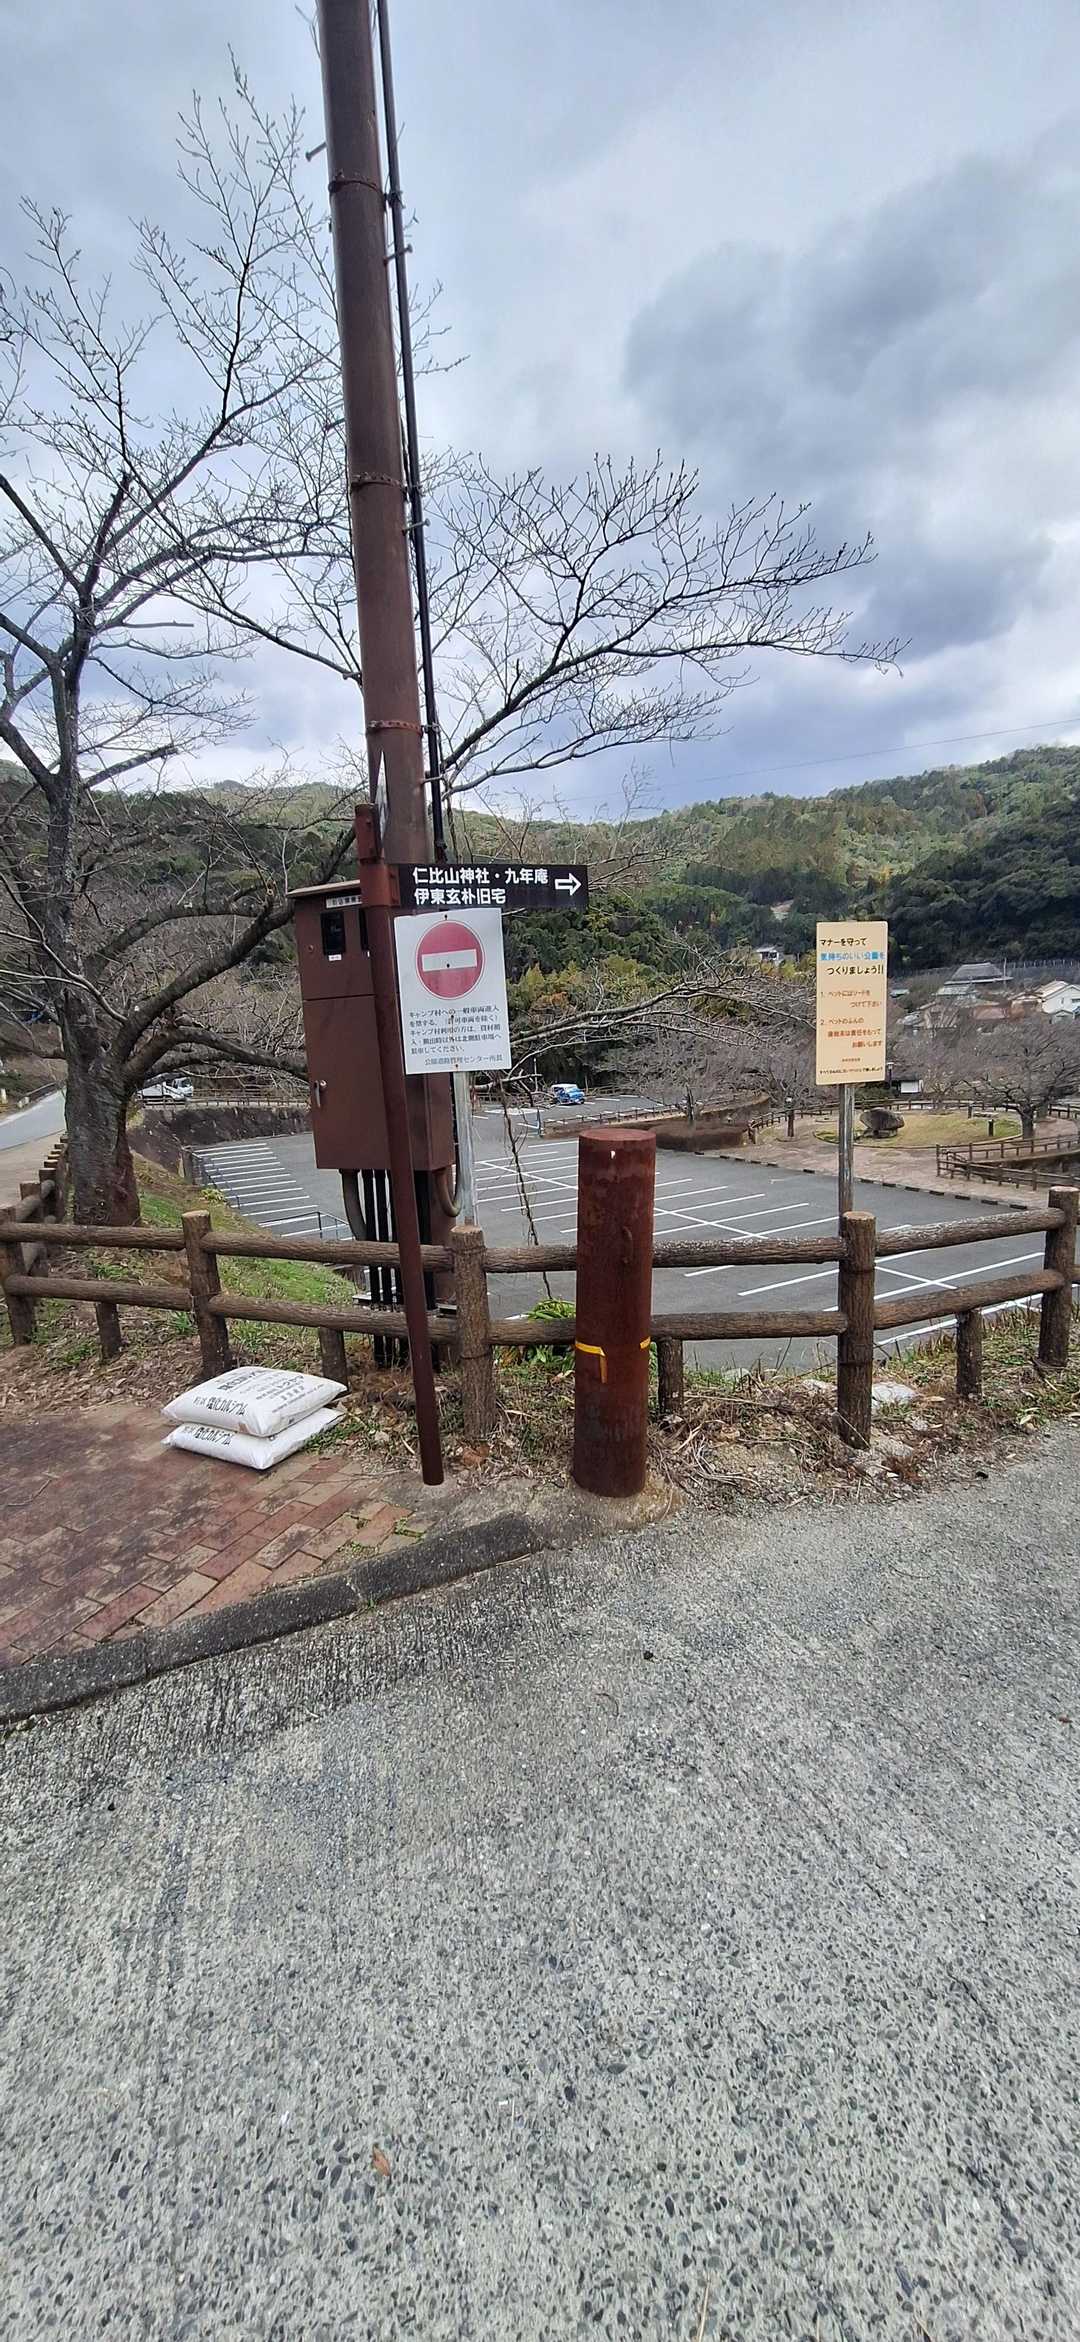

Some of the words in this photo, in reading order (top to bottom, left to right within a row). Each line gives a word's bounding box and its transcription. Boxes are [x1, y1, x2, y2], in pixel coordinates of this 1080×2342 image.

[413, 867, 549, 885] 仁比山神社・九年庵
[414, 888, 507, 905] 伊東玄朴旧宅
[820, 937, 867, 946] マナーを守って
[820, 951, 886, 961] 気持ちのいい公園を
